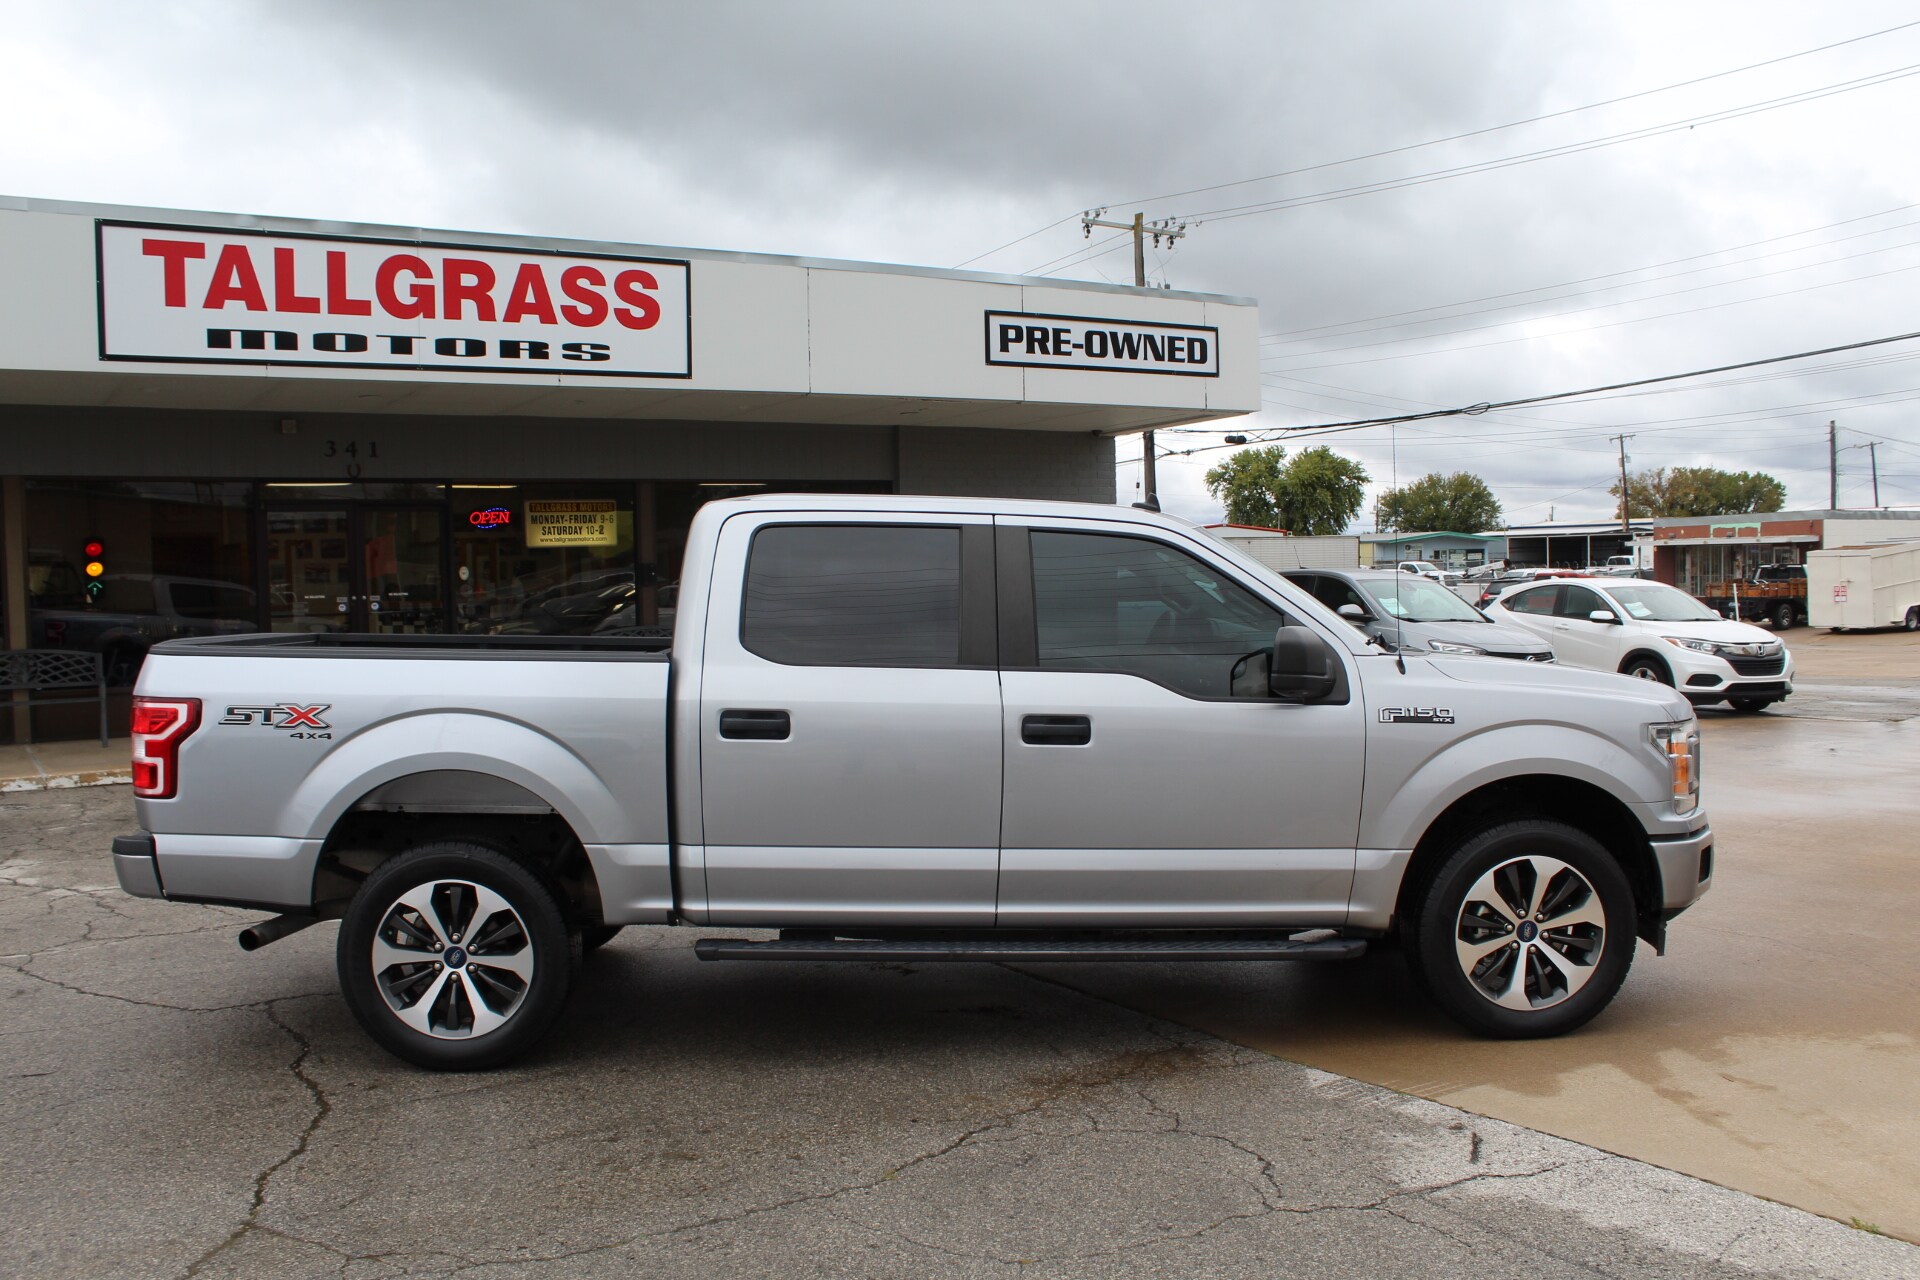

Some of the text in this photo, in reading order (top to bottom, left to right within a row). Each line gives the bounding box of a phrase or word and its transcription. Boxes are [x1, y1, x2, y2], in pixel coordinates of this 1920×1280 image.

[142, 238, 661, 330] TALLGRASS
[207, 328, 611, 362] MOTORS
[999, 324, 1208, 365] PRE-OWNED
[323, 440, 379, 458] 341
[531, 503, 614, 512] TALLGRASS MOTORS
[469, 511, 511, 524] OPEN
[531, 514, 614, 525] MONDAY-FRIDAY 9-6
[541, 525, 605, 536] SATURDAY 10-2
[218, 703, 333, 729] STX
